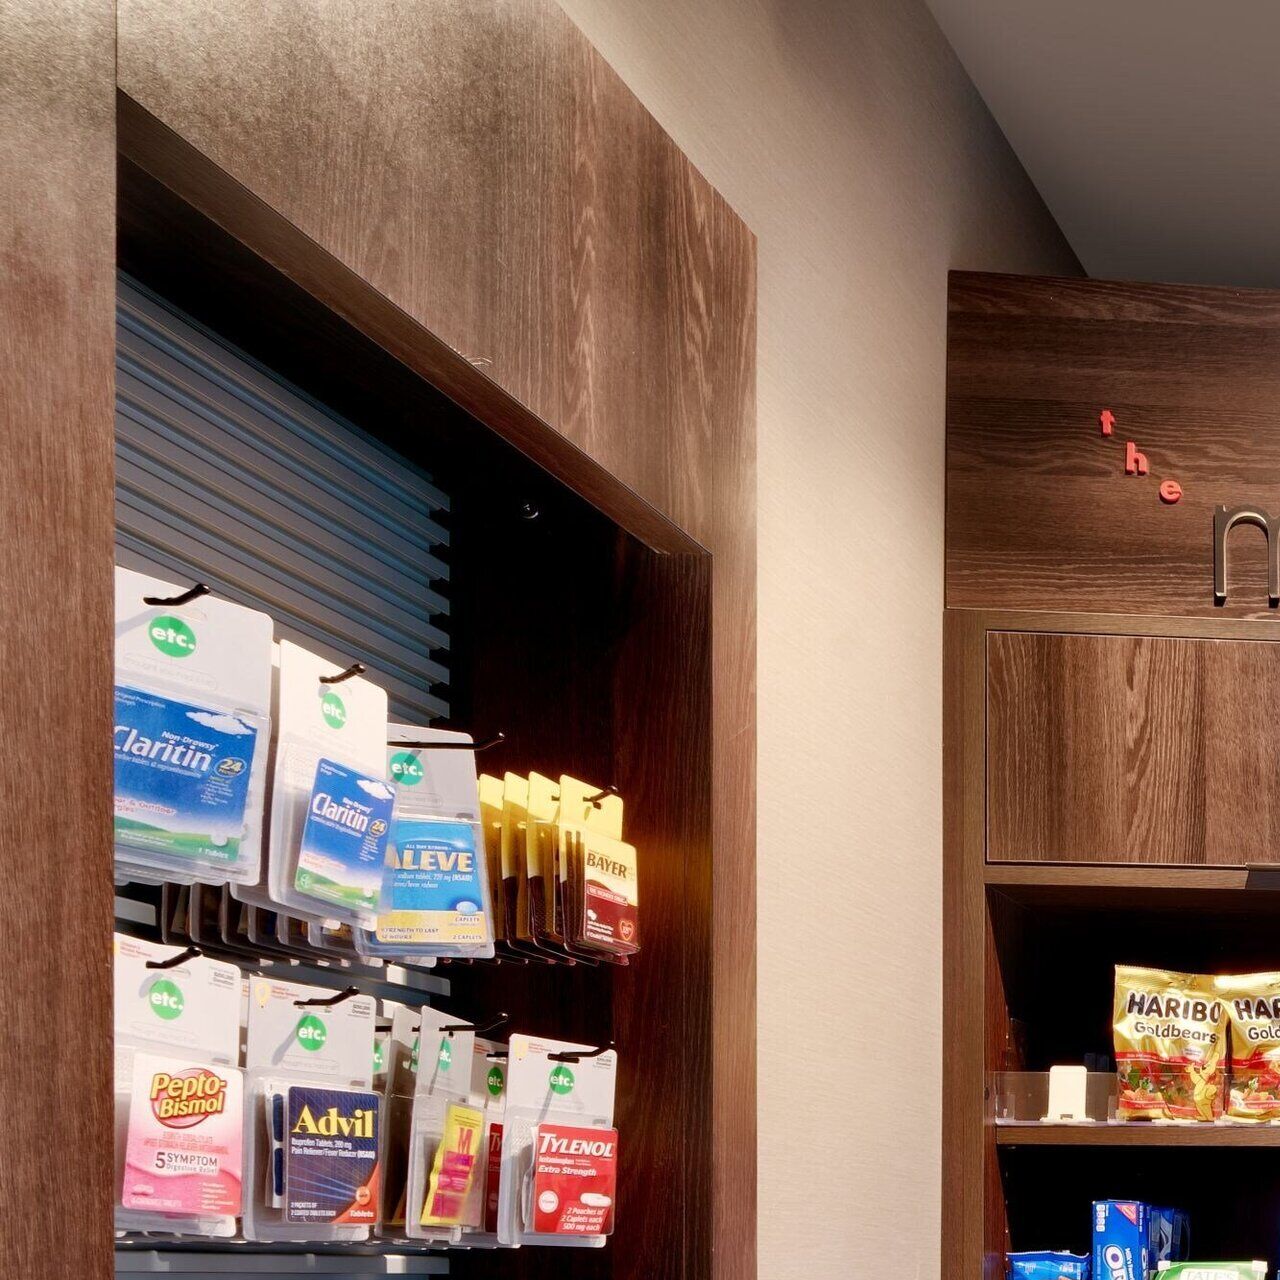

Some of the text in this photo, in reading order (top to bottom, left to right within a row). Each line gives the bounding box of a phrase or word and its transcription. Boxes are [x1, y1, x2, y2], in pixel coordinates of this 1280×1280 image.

[1100, 410, 1182, 503] the
[151, 626, 195, 650] etc.
[322, 703, 347, 723] etc.
[391, 763, 424, 778] etc.
[312, 792, 369, 833] Claritin
[586, 852, 628, 880] BAYER
[151, 990, 184, 1011] etc.
[299, 1025, 327, 1041] etc.
[1135, 1022, 1217, 1044] Goldbears
[151, 1071, 227, 1099] Pepto-
[550, 1074, 574, 1087] etc.
[158, 1092, 225, 1119] Bismol
[291, 1104, 376, 1138] Advil
[538, 1133, 614, 1158] TYLENOL
[155, 1151, 218, 1170] 5 SYMPTOM
[538, 1165, 597, 1177] Extra Strength
